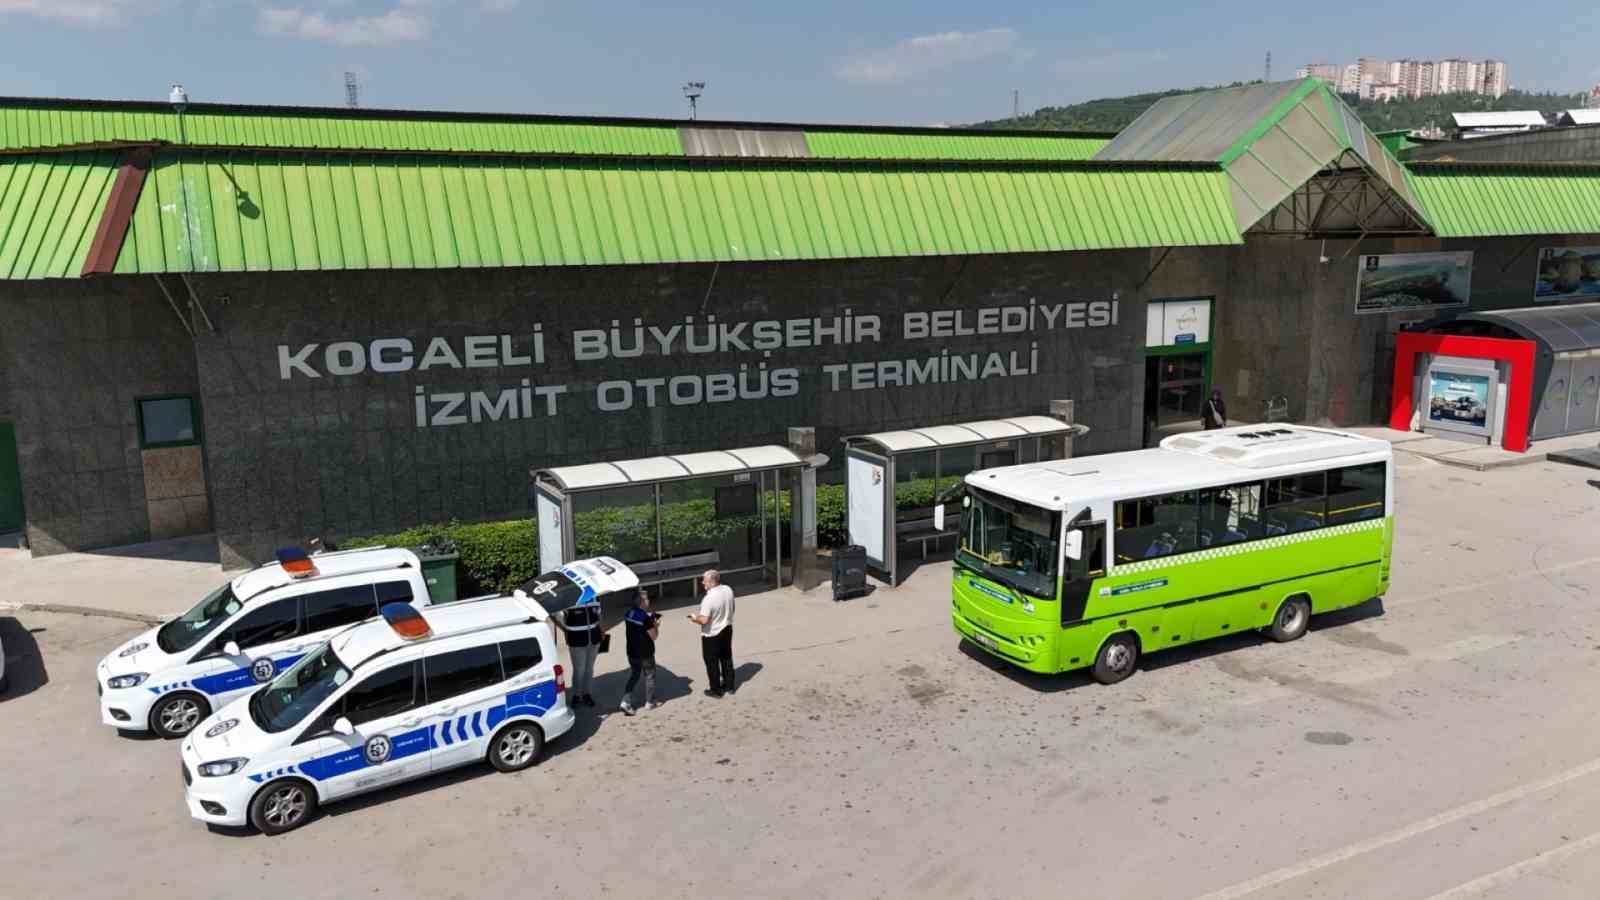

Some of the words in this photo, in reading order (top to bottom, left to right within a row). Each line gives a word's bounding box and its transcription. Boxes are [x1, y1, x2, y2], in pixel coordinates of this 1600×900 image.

[278, 323, 545, 380] KOCAELİ
[573, 308, 881, 358] BÜYÜKŞEHİR
[904, 293, 1120, 340] BELEDİYESİ
[415, 379, 567, 428] İZMİT
[596, 362, 800, 412] OTOBÜS
[823, 342, 1040, 392] TERMİNALİ
